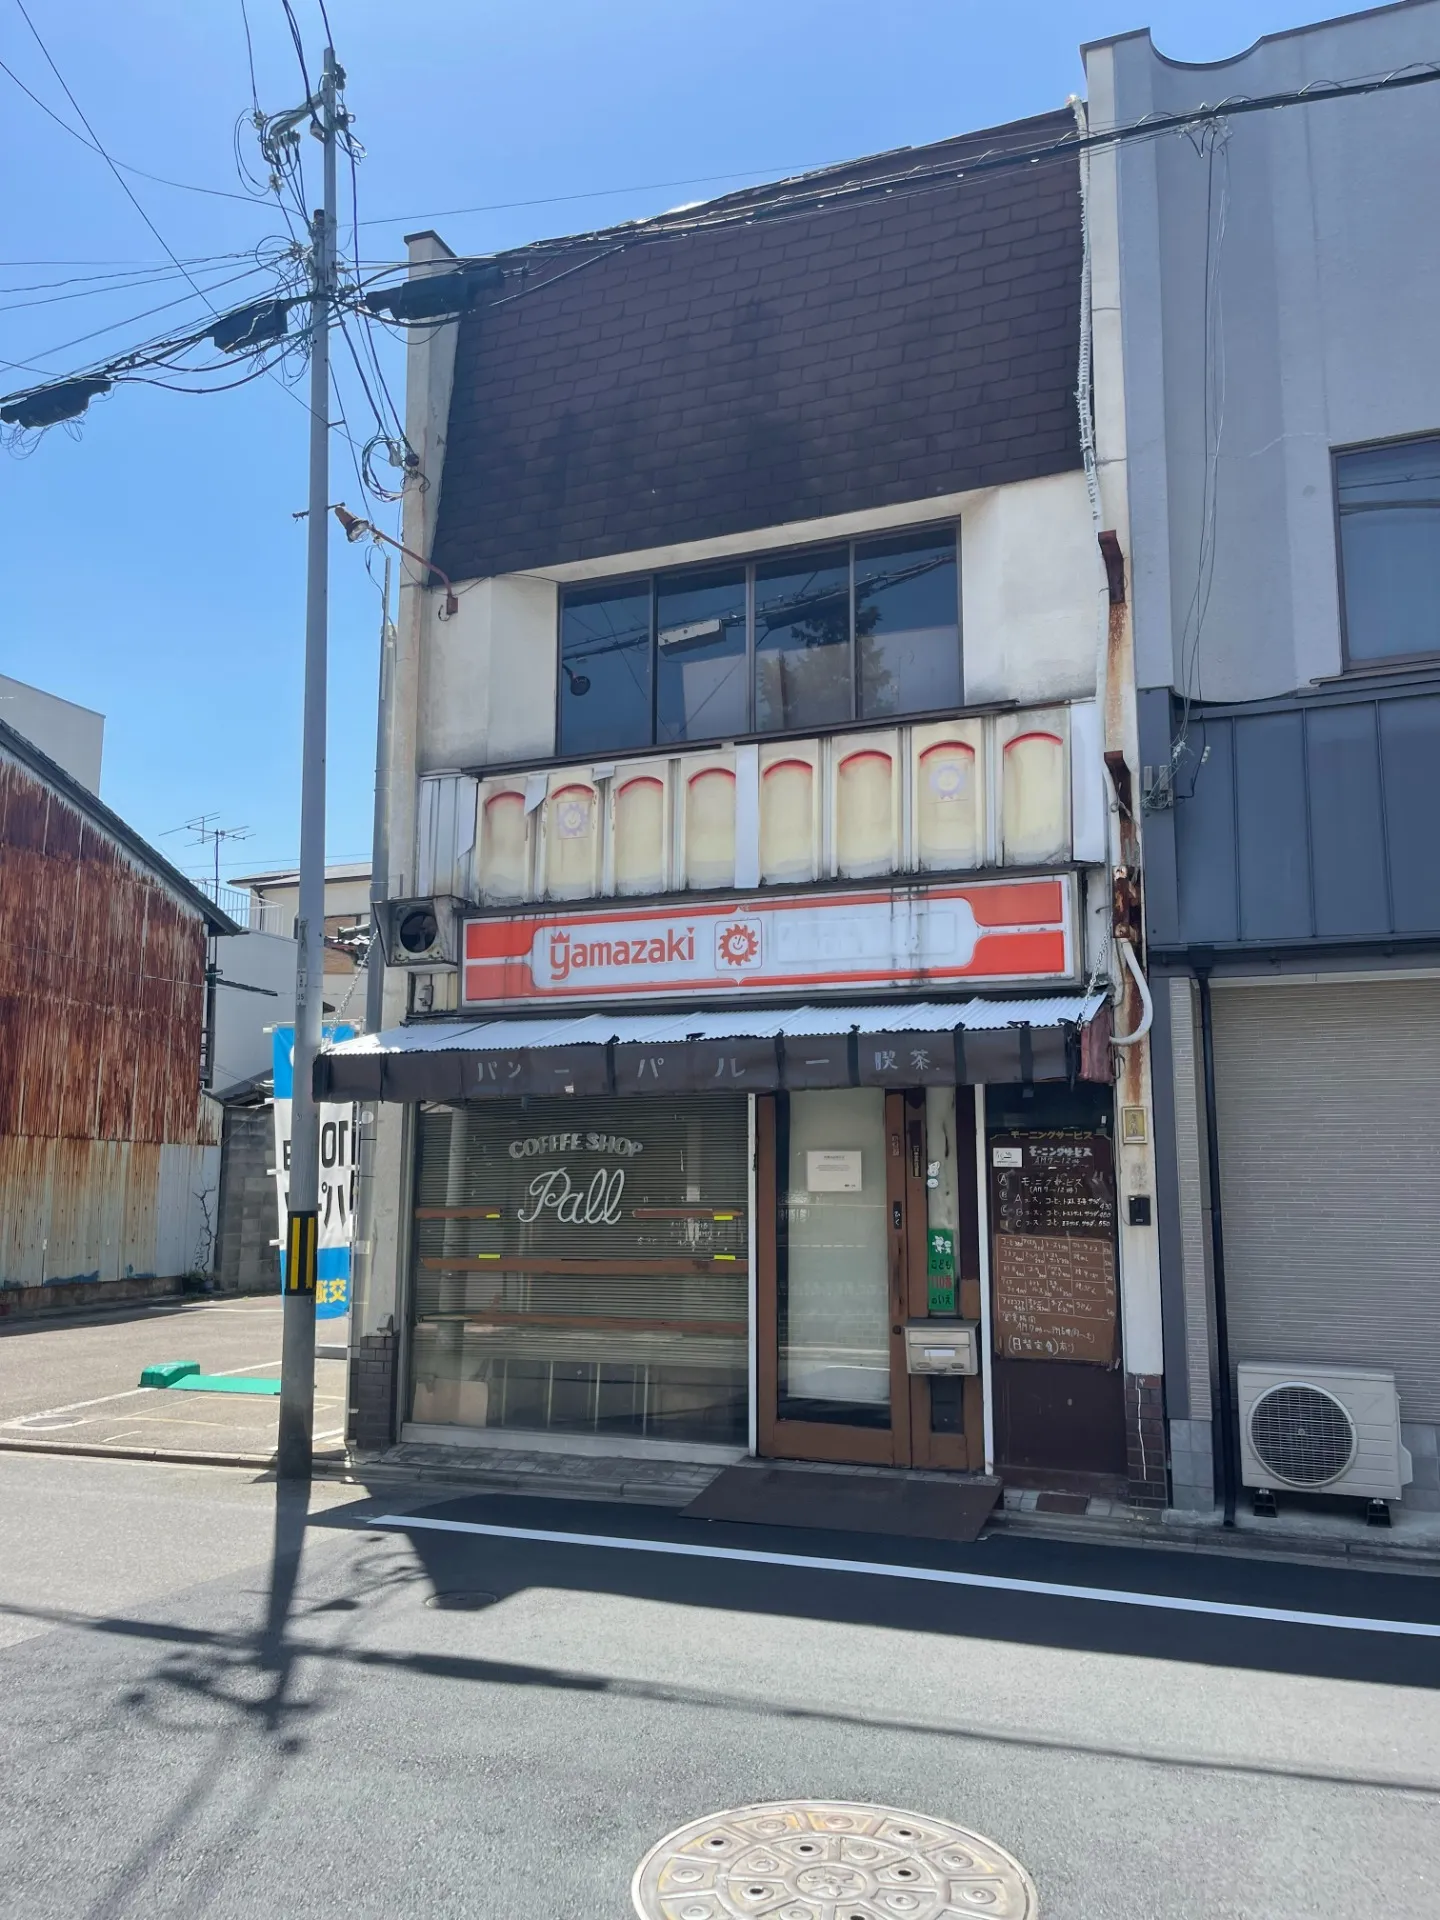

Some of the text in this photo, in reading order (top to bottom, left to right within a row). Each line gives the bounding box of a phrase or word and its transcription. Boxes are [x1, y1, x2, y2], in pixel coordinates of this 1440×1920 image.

[550, 926, 696, 981] yamazaki
[586, 1131, 643, 1157] SHOP
[1010, 1130, 1093, 1140] モーニングサービス
[517, 1167, 625, 1225] Pall
[931, 1259, 952, 1270] こども
